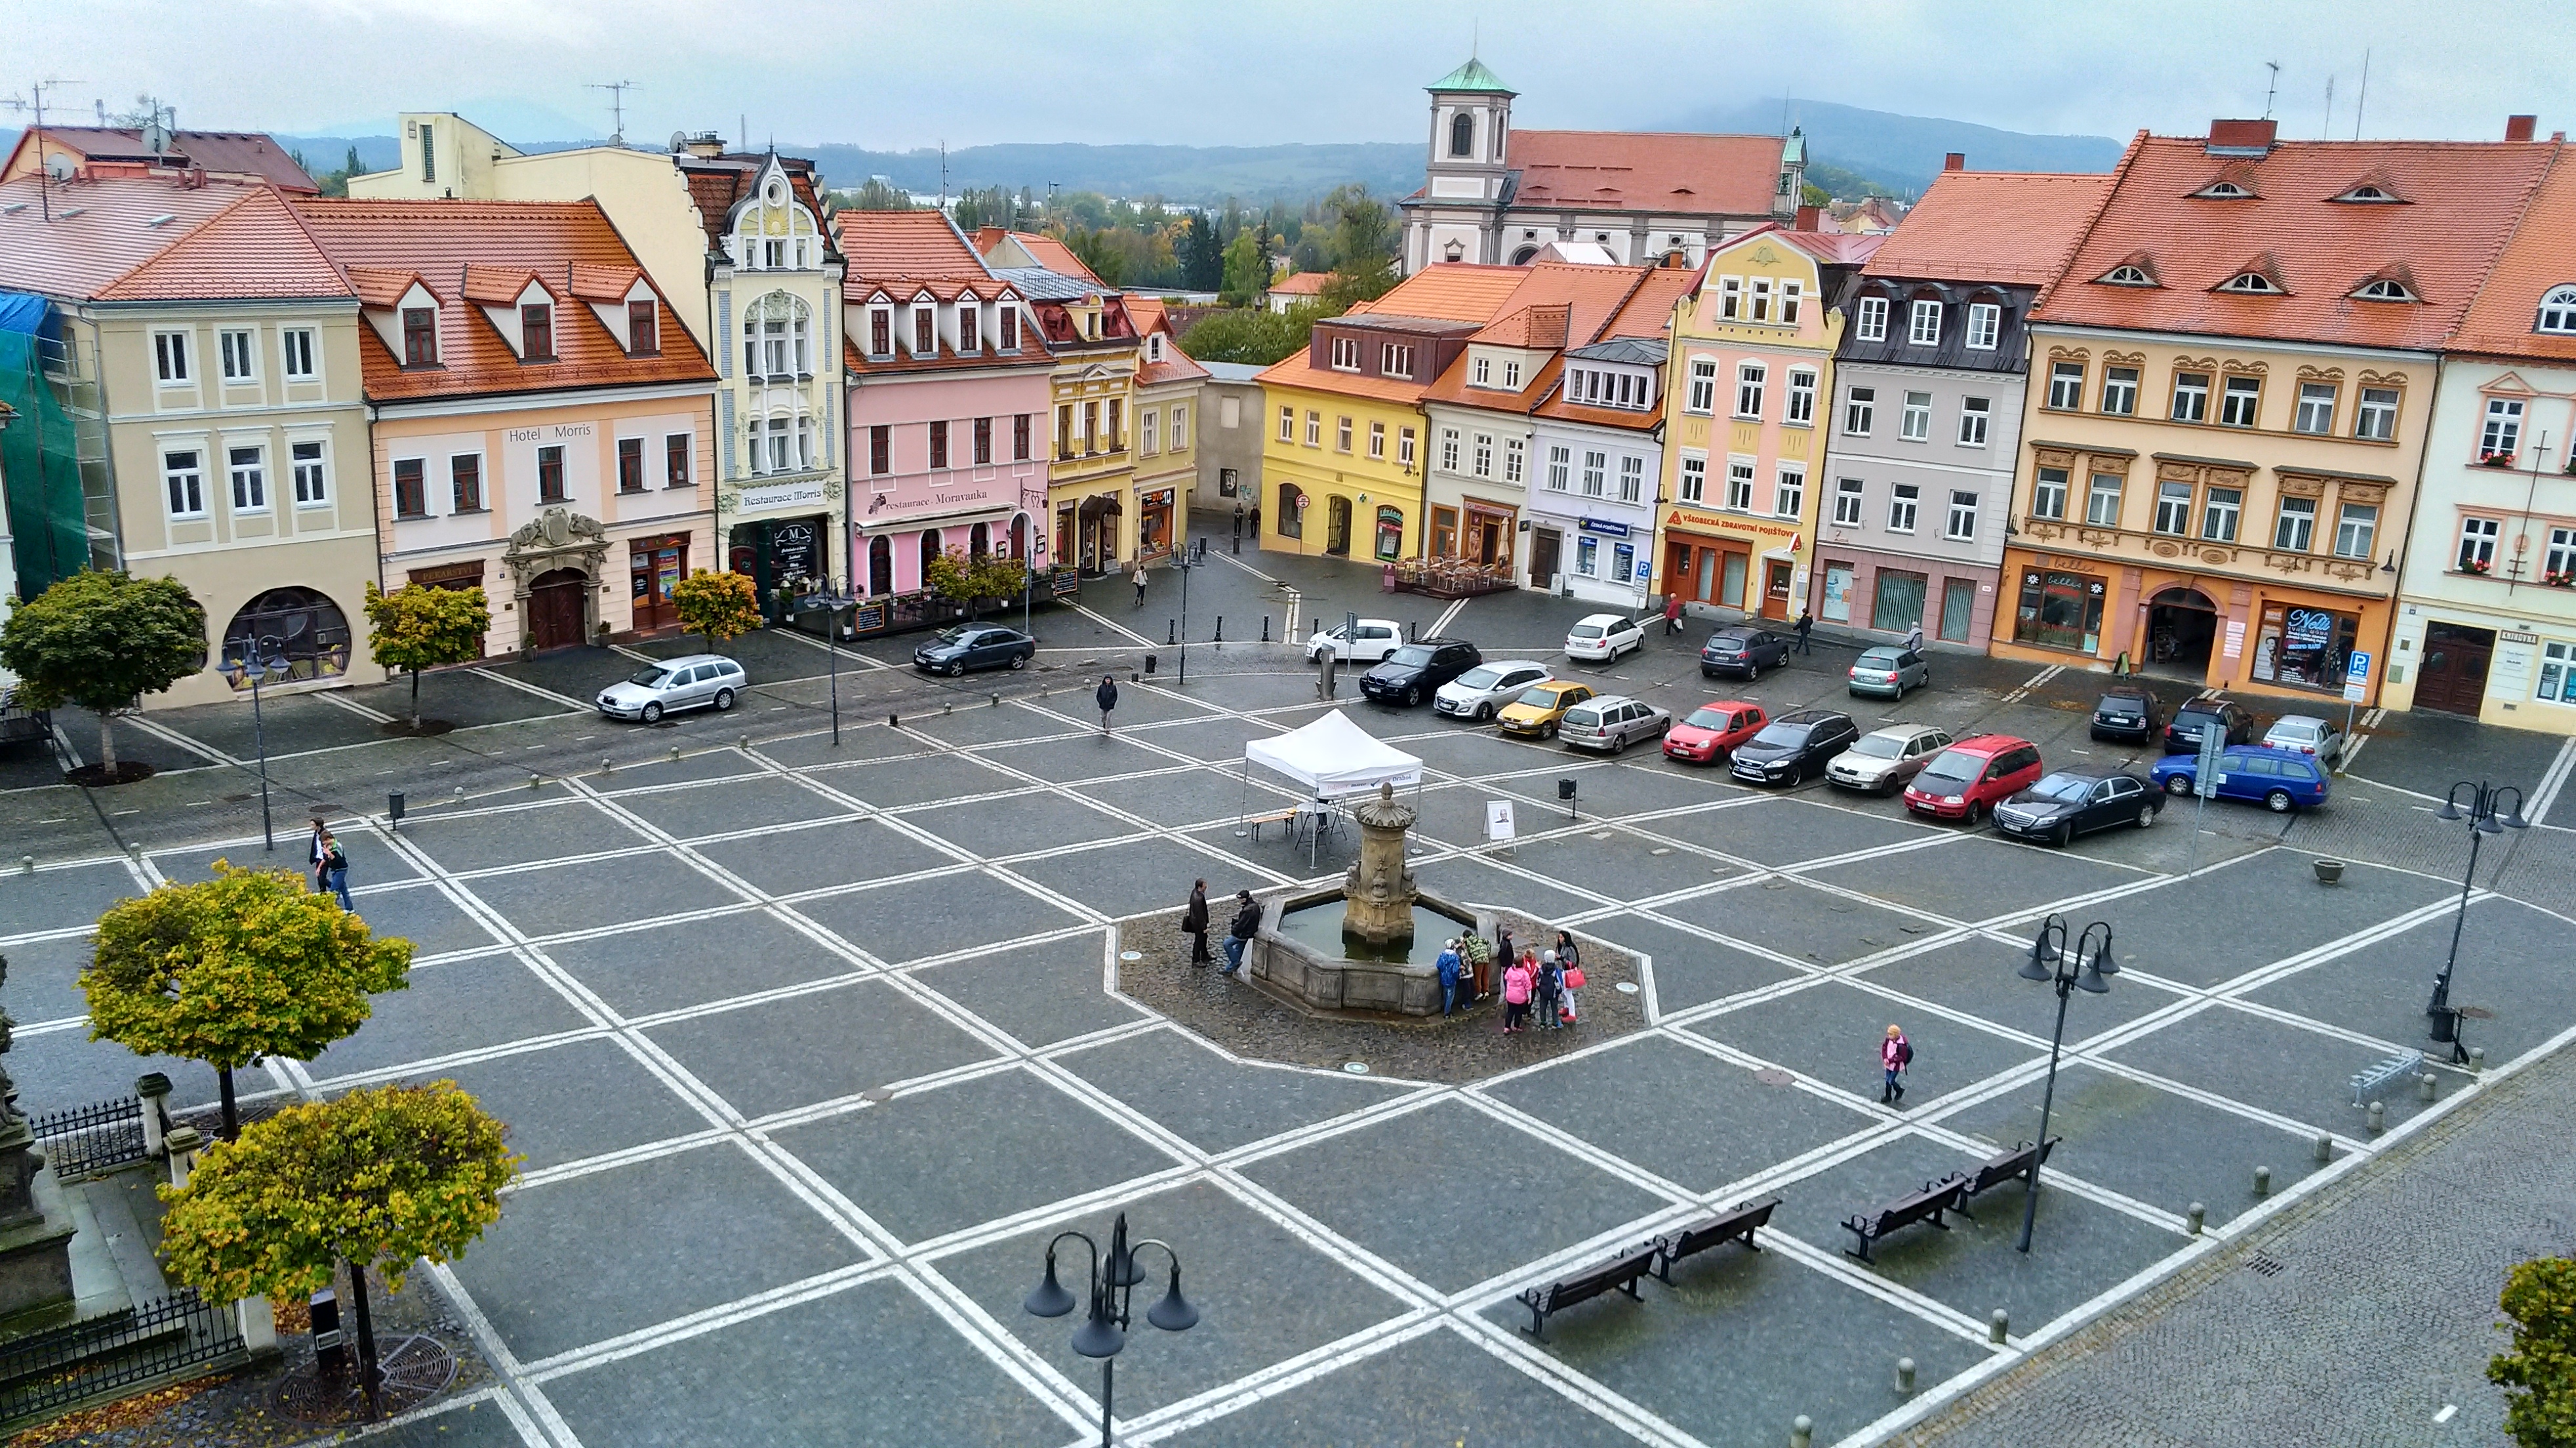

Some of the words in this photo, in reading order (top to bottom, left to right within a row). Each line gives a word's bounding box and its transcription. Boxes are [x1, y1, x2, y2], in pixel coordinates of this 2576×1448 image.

[510, 428, 540, 442] Hotel
[555, 424, 591, 437] Morris
[744, 494, 792, 506] Restaurace
[794, 489, 822, 500] Morris
[886, 498, 930, 510] restaurace
[935, 490, 988, 504] Moravanka
[1683, 514, 1720, 526] VŠEOBECNÁ
[1721, 521, 1758, 532] ZDRAVOTNÍ
[1639, 563, 1648, 574] P
[2047, 576, 2082, 588] bellis
[2287, 609, 2331, 631] Nelli
[2353, 654, 2367, 669] P
